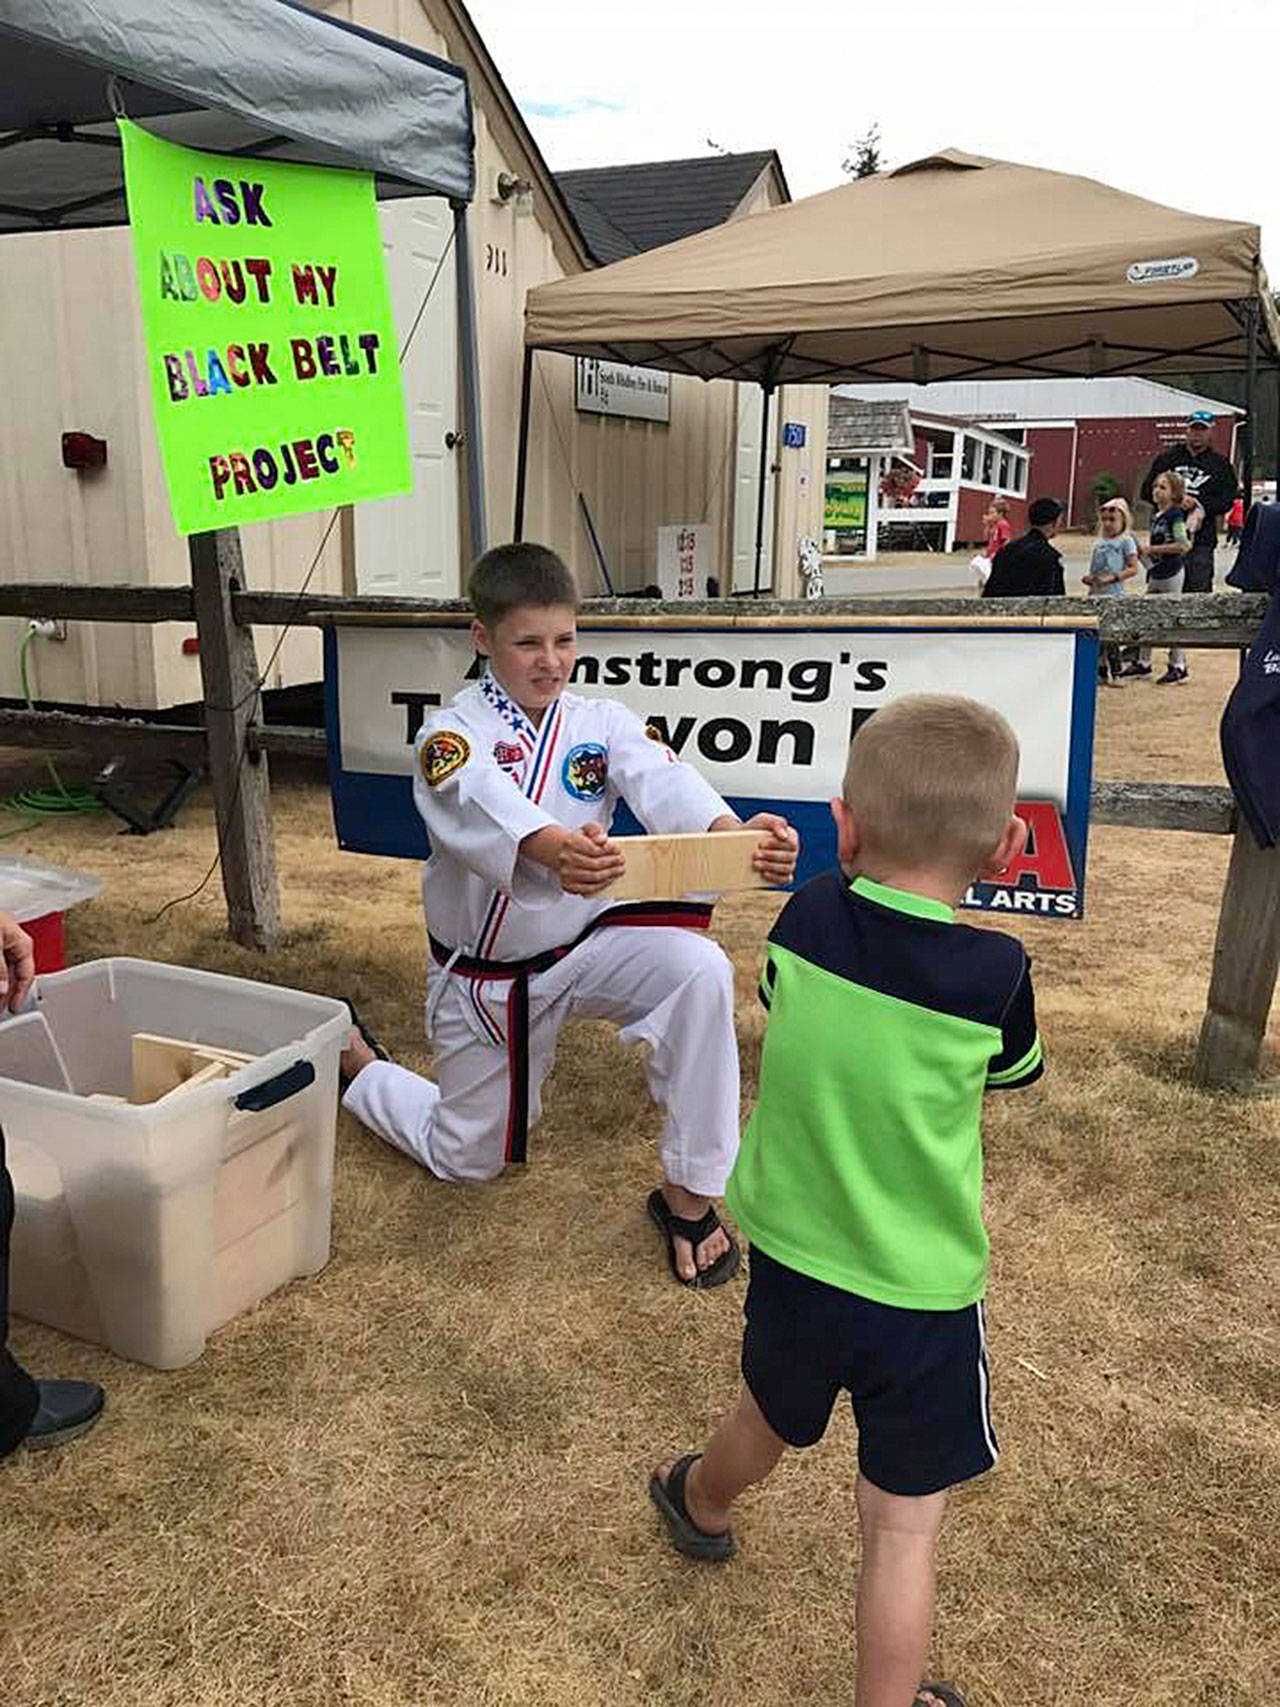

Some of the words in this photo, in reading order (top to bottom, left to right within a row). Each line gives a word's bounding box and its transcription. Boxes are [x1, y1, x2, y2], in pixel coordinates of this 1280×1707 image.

[194, 176, 273, 227] ASK
[160, 250, 272, 305] ABOUT
[291, 263, 337, 307] MY
[164, 342, 278, 402] BLACK
[290, 333, 380, 381] BELT
[208, 427, 355, 500] PROJECT
[990, 889, 1078, 914] ARTS
